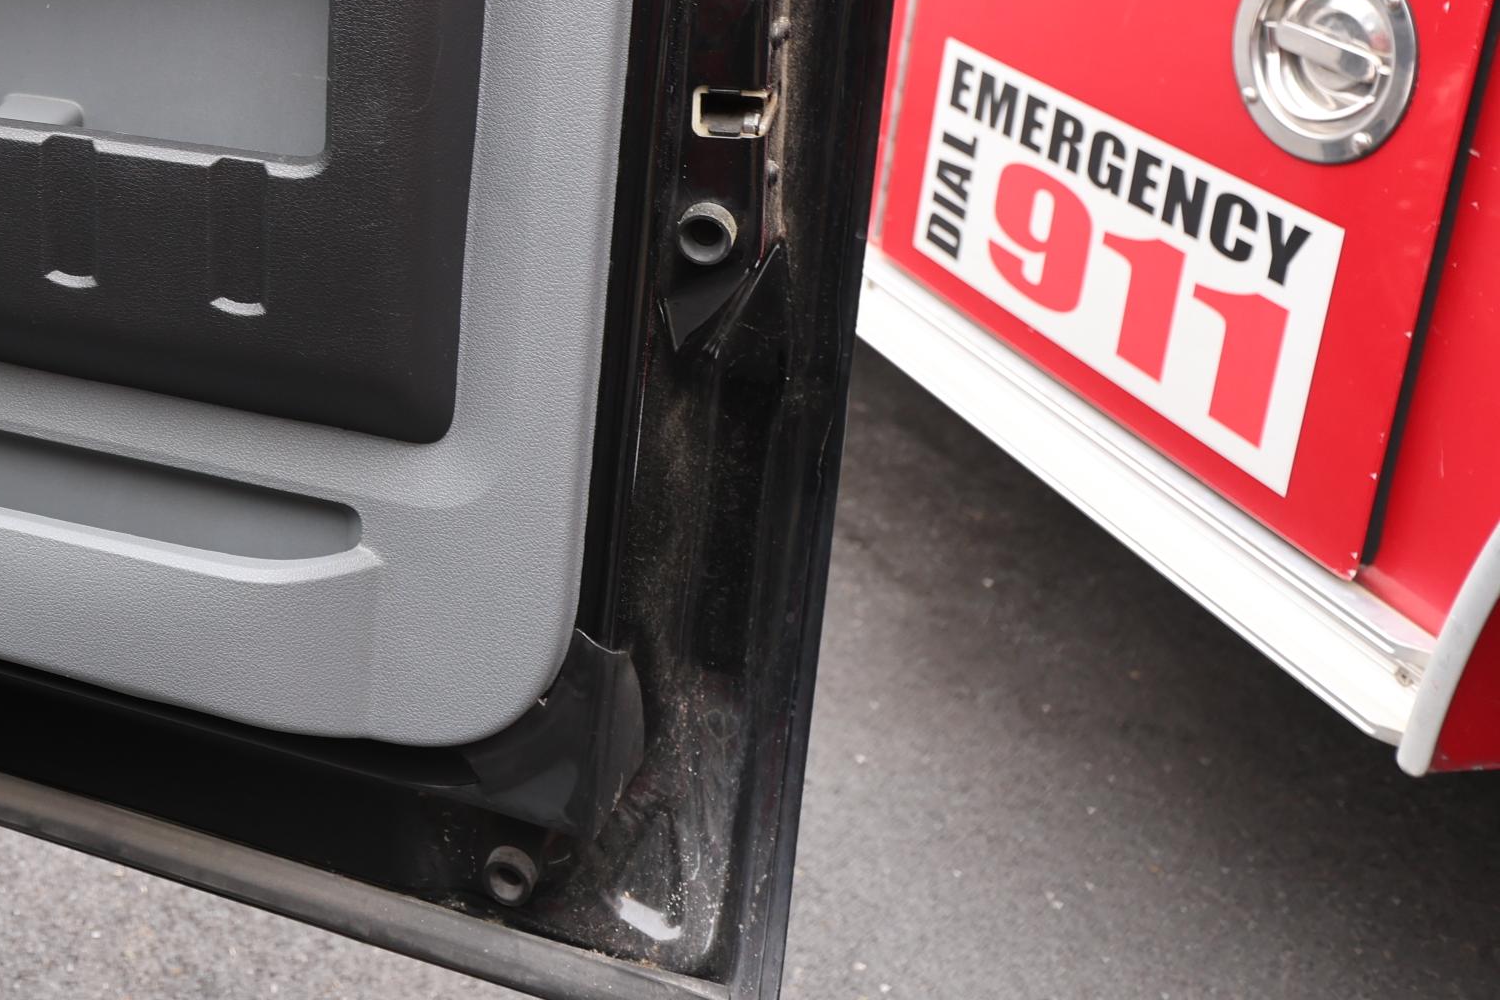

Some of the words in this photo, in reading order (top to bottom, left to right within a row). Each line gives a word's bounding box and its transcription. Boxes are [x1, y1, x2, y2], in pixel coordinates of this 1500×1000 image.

[925, 130, 979, 261] DIAL
[950, 58, 1312, 288] EMERGENCY
[987, 161, 1290, 451] 911
